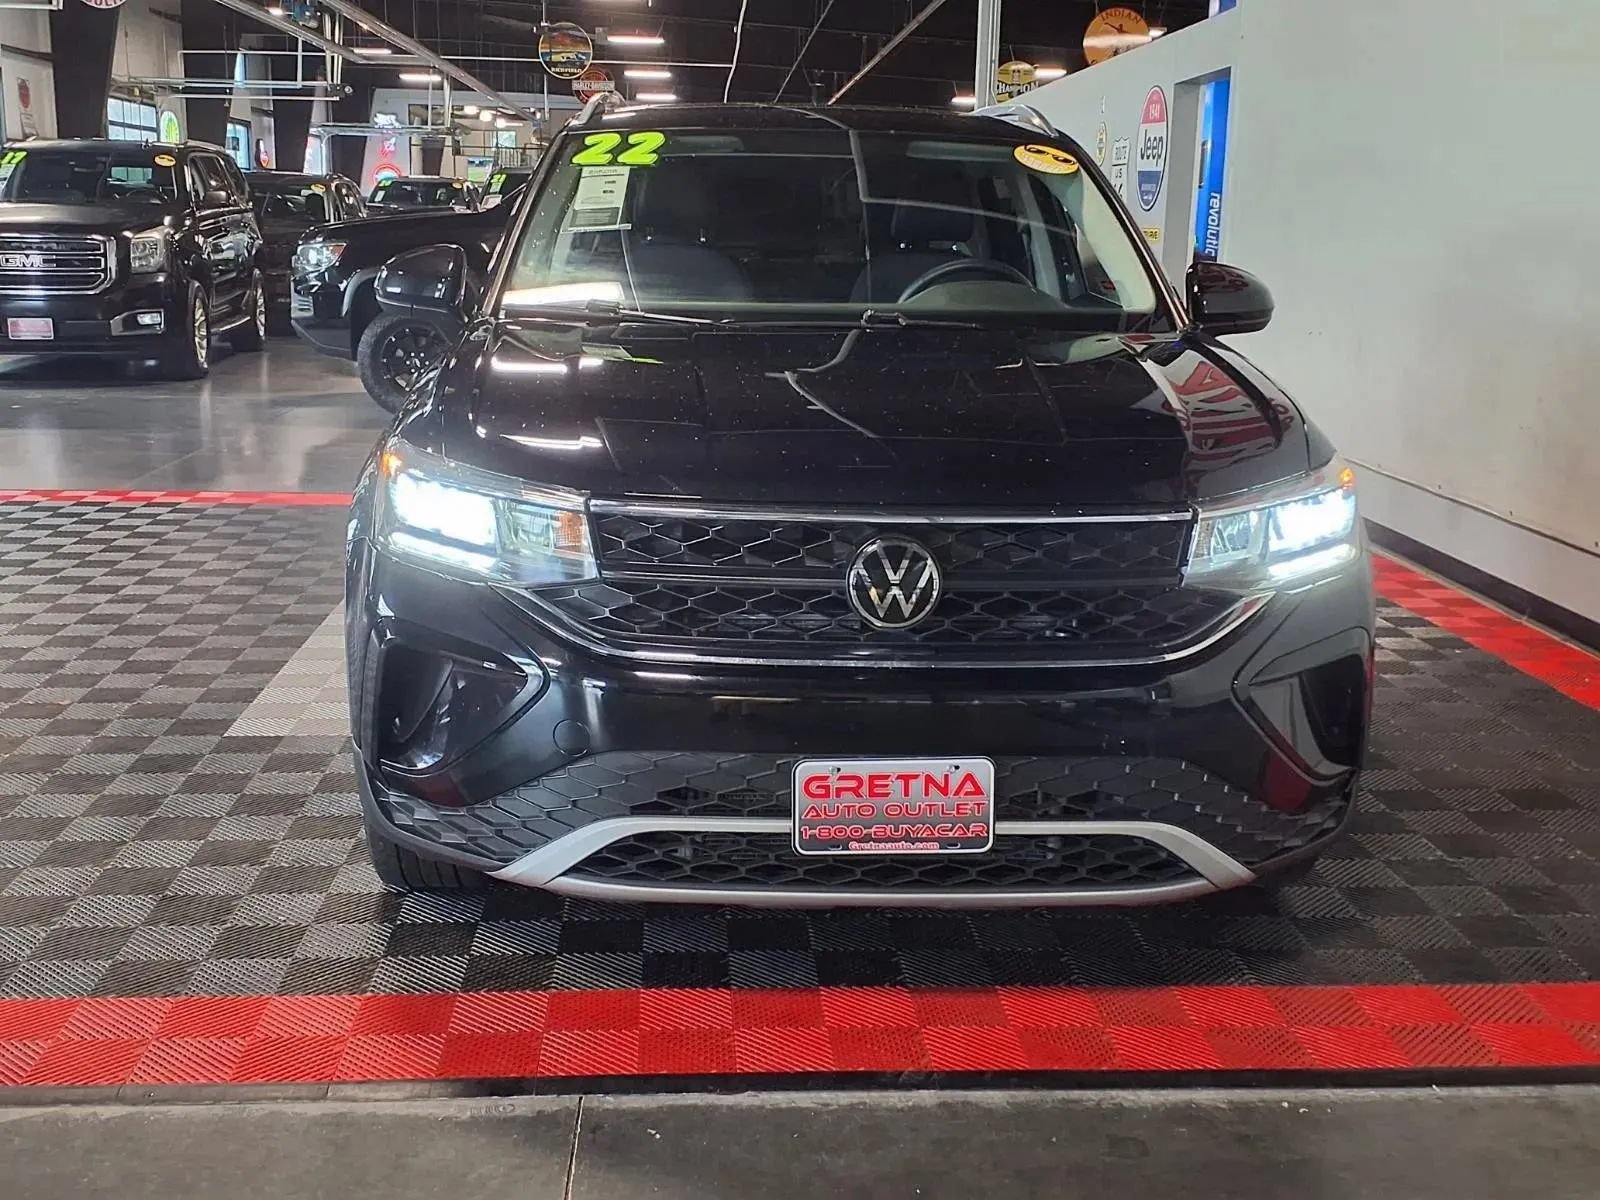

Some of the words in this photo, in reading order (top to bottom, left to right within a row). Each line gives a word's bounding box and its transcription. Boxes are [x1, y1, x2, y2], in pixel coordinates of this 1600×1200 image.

[1101, 9, 1141, 24] INDIAN
[572, 131, 665, 165] 22
[1141, 129, 1163, 166] Jeep
[0, 254, 56, 267] GMC
[852, 541, 938, 622] VW
[803, 772, 986, 799] GRETNA
[802, 802, 876, 819] AUTO
[884, 801, 988, 817] OUTLET
[848, 841, 939, 850] Gretnaauto.com
